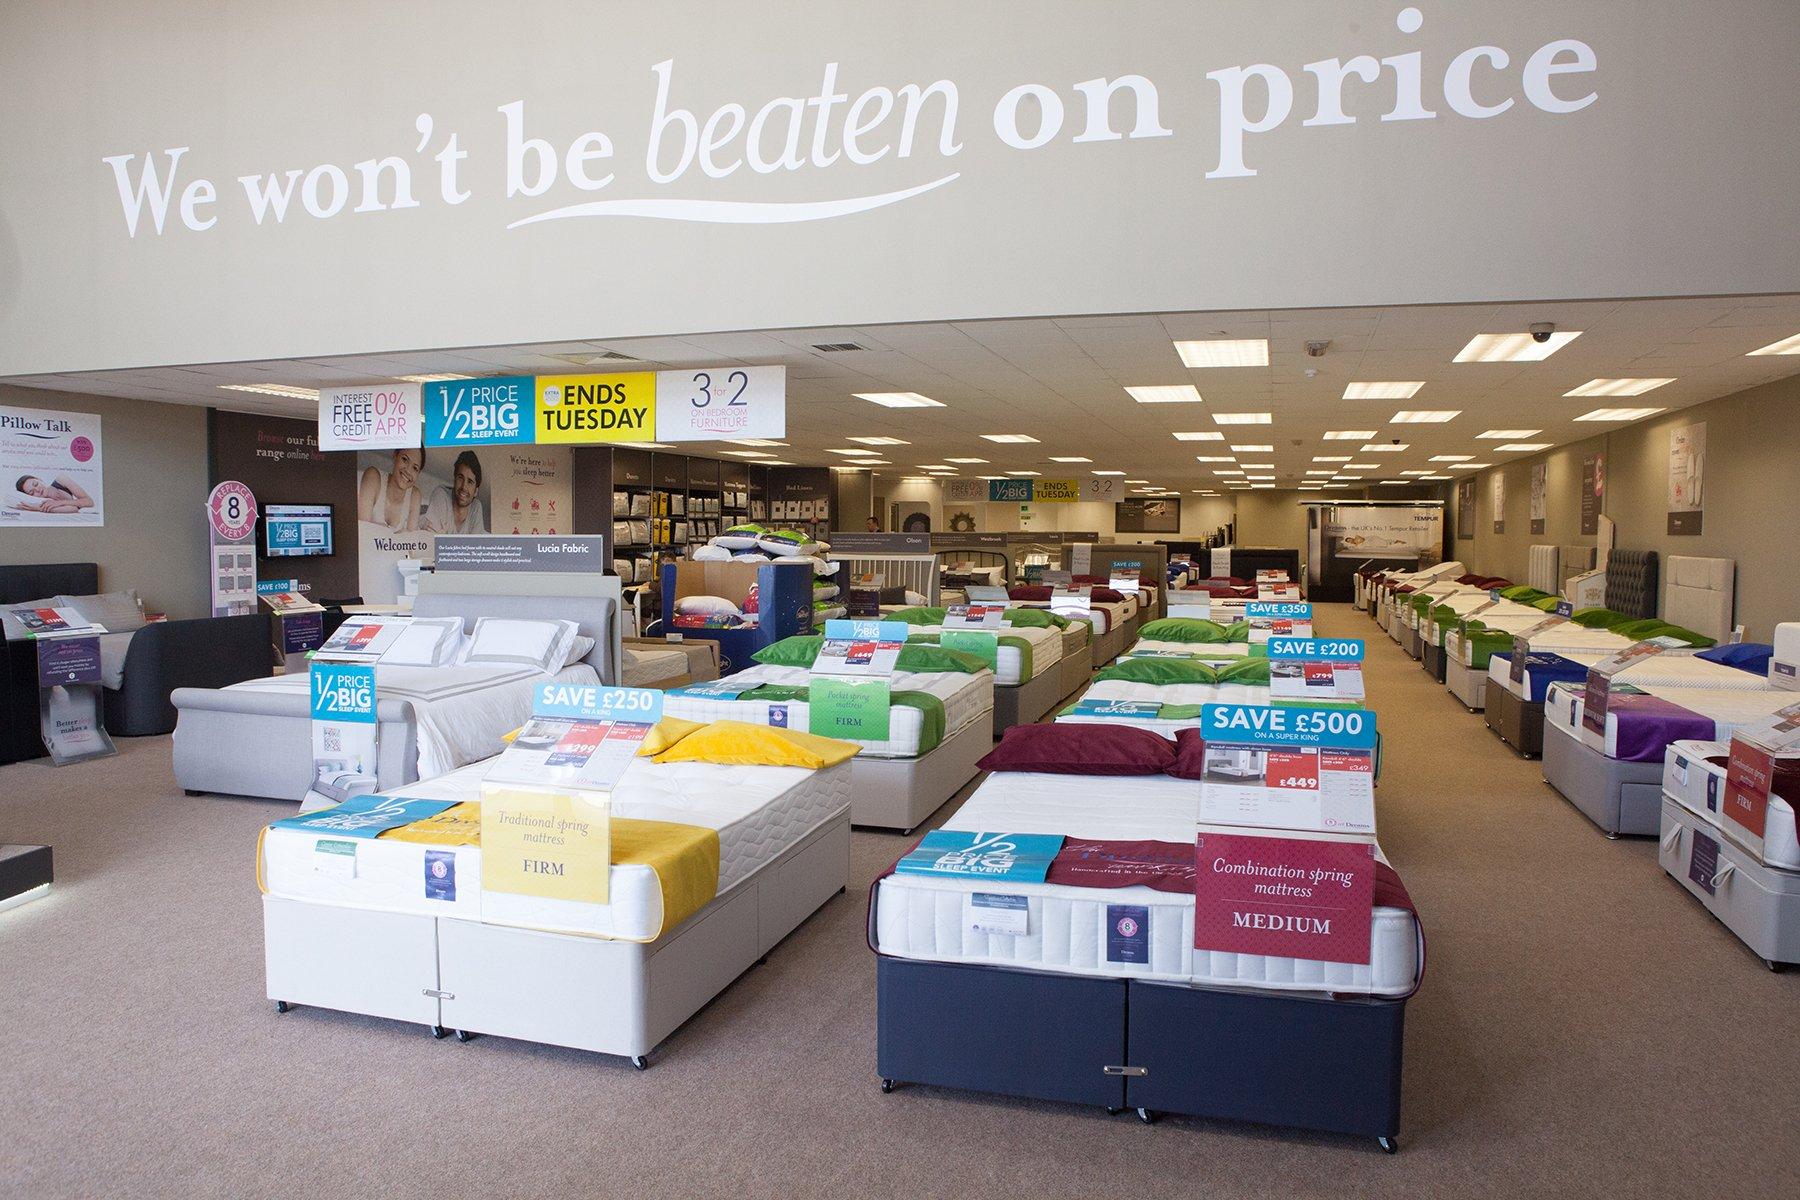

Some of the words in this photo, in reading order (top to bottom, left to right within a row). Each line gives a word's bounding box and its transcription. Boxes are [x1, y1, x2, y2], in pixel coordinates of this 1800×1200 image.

[102, 146, 218, 239] We
[238, 113, 472, 226] won't
[497, 99, 615, 199] be
[646, 58, 963, 184] beaten
[993, 74, 1173, 150] on
[1205, 7, 1599, 179] price
[471, 385, 519, 403] PRICE
[564, 382, 626, 406] ENDS
[692, 372, 711, 408] 3
[714, 386, 727, 397] for
[728, 371, 749, 406] 2
[333, 393, 373, 404] INTEREST
[374, 391, 407, 416] 0%
[333, 403, 372, 423] FREE
[471, 403, 519, 431] BIG
[543, 407, 648, 431] TUESDAY
[691, 408, 705, 416] ON
[706, 408, 749, 416] BEDROOM
[0, 416, 42, 430] Pillow
[44, 419, 72, 432] Talk
[374, 417, 407, 436] APR
[691, 417, 749, 428] FURNITURE
[333, 423, 373, 437] CREDIT
[471, 431, 493, 439] SLEEP
[494, 429, 519, 438] EVENT
[287, 437, 305, 445] our
[256, 449, 285, 462] range
[287, 449, 310, 460] online
[216, 483, 251, 499] REPLACE
[1008, 488, 1027, 498] BIG
[1044, 482, 1068, 490] ENDS
[1091, 480, 1100, 493] 3
[1104, 480, 1113, 493] 2
[1036, 490, 1076, 499] TUESDAY
[228, 496, 240, 519] 8
[218, 524, 242, 538] EVERY
[285, 529, 299, 538] BIG
[374, 538, 416, 552] Welcome
[418, 540, 428, 551] to
[537, 543, 560, 553] Lucia
[562, 543, 589, 554] Fabric
[1250, 603, 1279, 613] SAVE
[1281, 604, 1308, 614] £350
[863, 627, 880, 636] BIG
[1273, 641, 1316, 655] SAVE
[1320, 642, 1359, 656] £200
[337, 674, 370, 688] PRICE
[338, 688, 371, 708] BIG
[542, 685, 596, 708] SAVE
[602, 689, 653, 711] £250
[828, 690, 849, 699] Pocket
[851, 691, 870, 702] spring
[835, 700, 862, 709] mattress
[56, 719, 78, 728] Better
[836, 717, 862, 727] FIRM
[1213, 706, 1286, 731] SAVE
[1295, 711, 1363, 735] £500
[60, 726, 83, 734] makes
[1276, 732, 1299, 740] SUPER
[1300, 734, 1320, 742] KING
[1279, 777, 1317, 788] £449
[1737, 793, 1751, 811] FIRM
[498, 810, 555, 828] Traditional
[556, 818, 590, 837] spring
[523, 831, 566, 846] mattress
[522, 858, 565, 876] FIRM
[932, 862, 969, 872] SLEEP
[970, 866, 1011, 874] EVENT
[1212, 857, 1306, 879] Combination
[1308, 867, 1354, 888] spring
[1253, 883, 1313, 898] mattress
[1124, 922, 1131, 931] 8
[1232, 911, 1332, 935] MEDIUM
